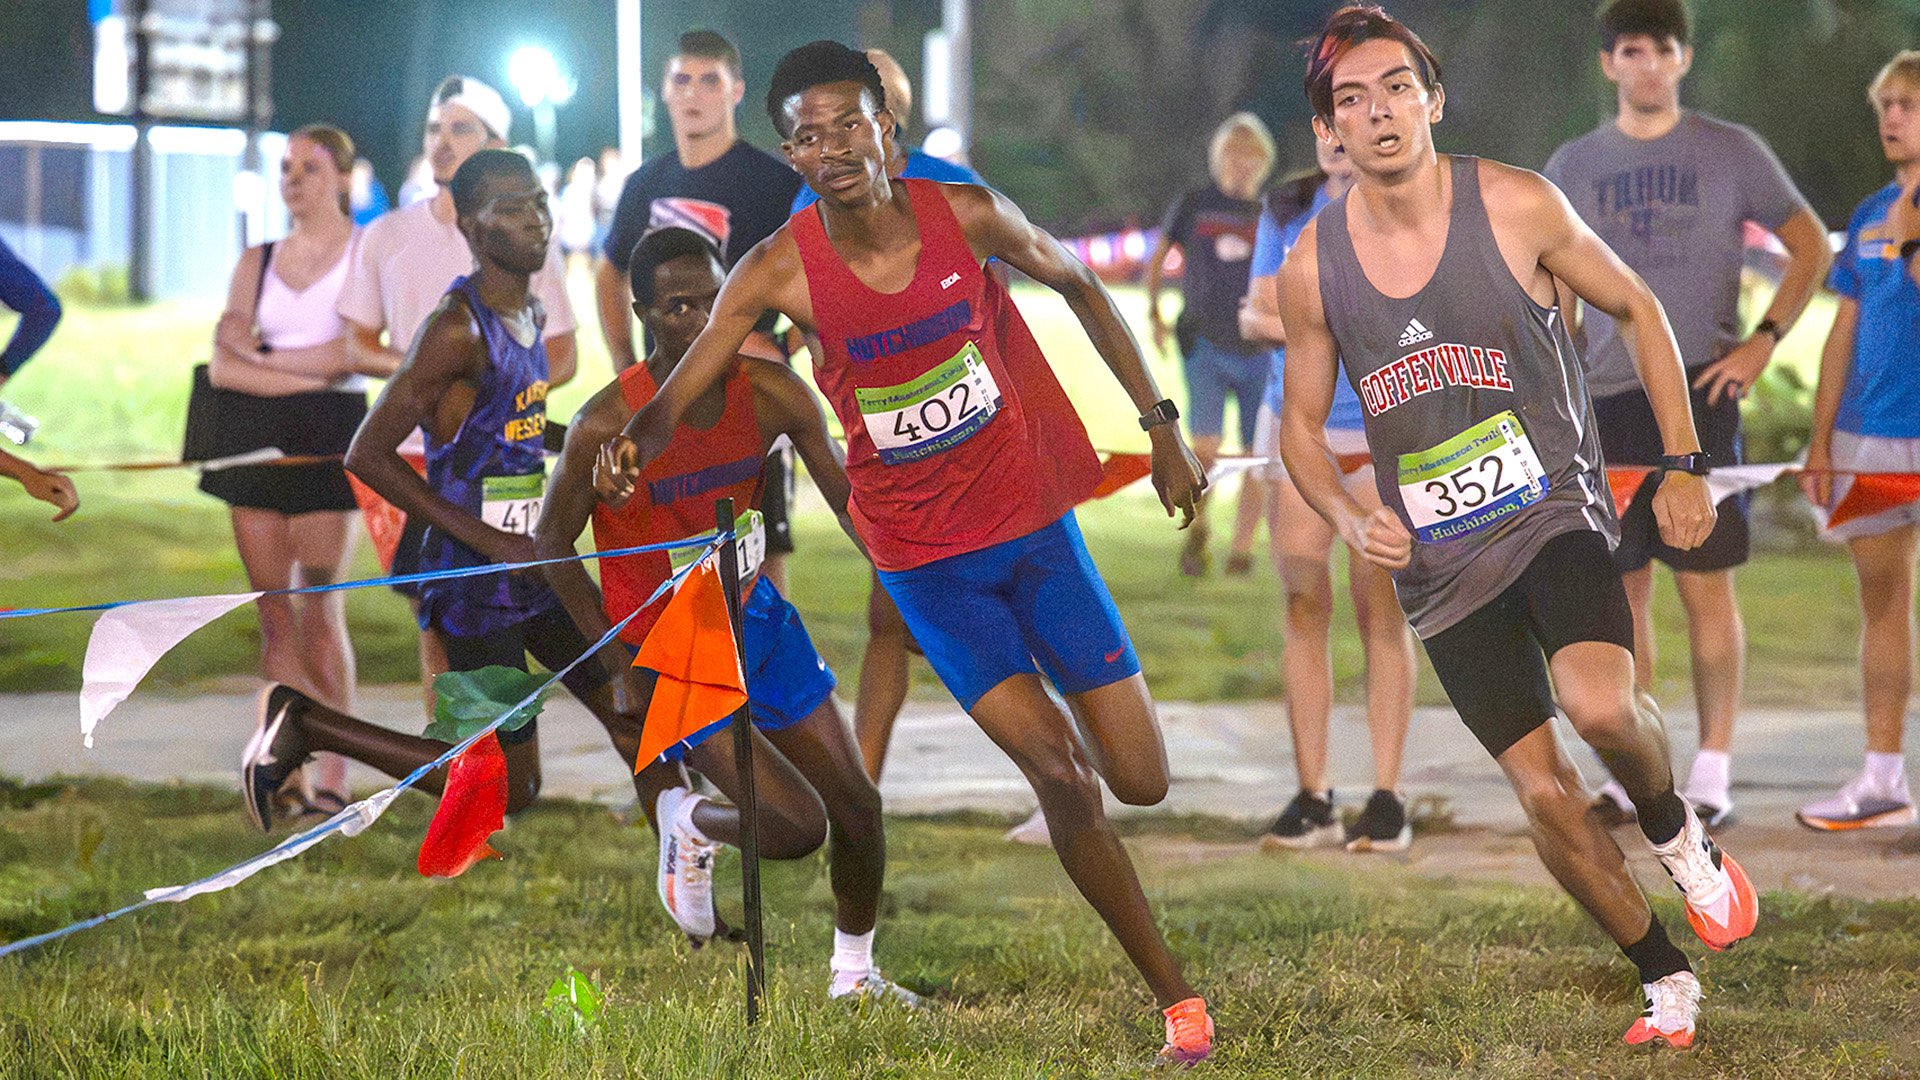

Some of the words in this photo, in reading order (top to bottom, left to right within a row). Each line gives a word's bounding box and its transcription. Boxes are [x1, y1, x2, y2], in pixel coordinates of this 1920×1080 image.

[1398, 330, 1434, 347] adidas
[1360, 343, 1514, 417] COFFEYVILLE
[893, 383, 979, 442] 402
[1425, 455, 1515, 517] 352
[1429, 503, 1521, 541] Hutchinson,
